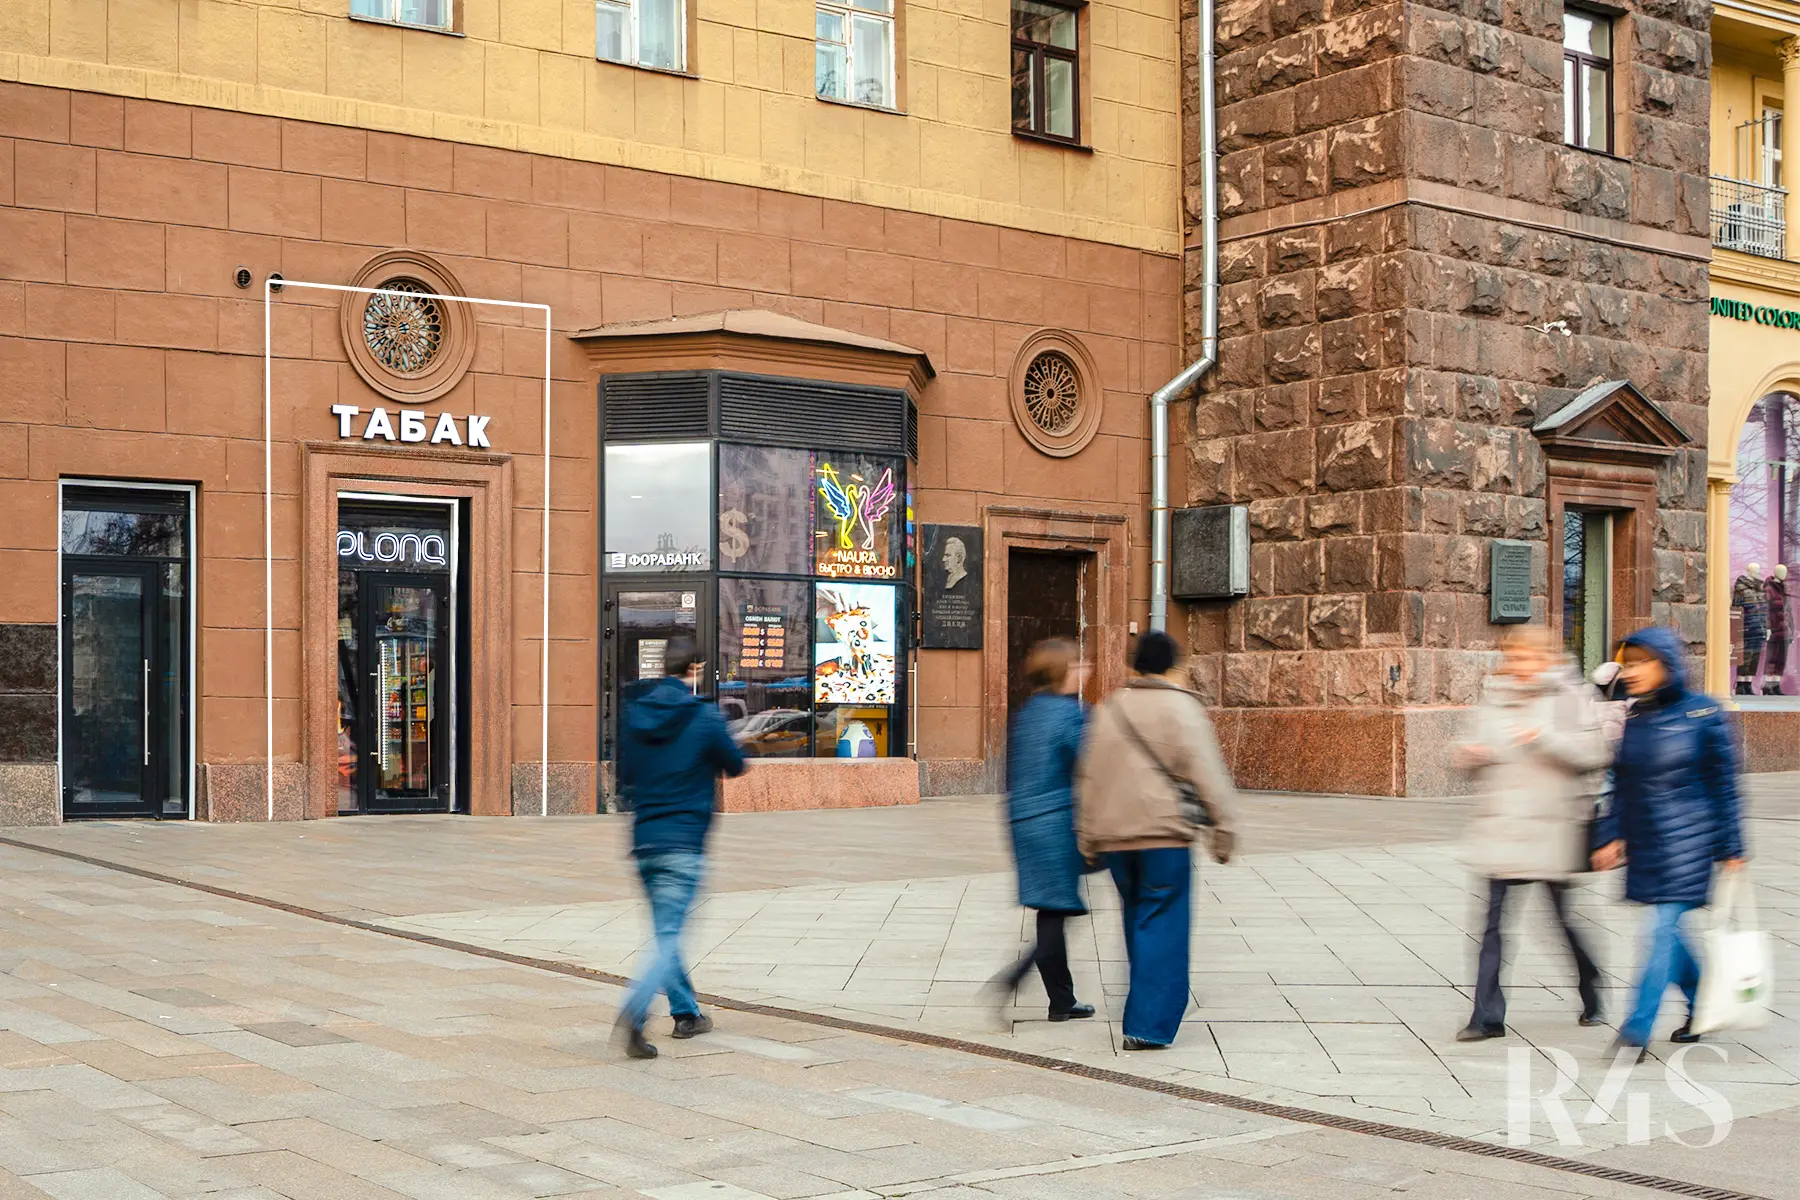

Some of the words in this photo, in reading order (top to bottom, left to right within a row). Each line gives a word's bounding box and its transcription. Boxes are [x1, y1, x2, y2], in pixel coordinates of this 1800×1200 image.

[330, 404, 491, 448] ТАБАК
[628, 552, 702, 566] ФОРАБАНК
[837, 550, 878, 564] NAURA
[819, 563, 852, 574] БЫСТРО
[862, 565, 896, 577] ВКУСНО
